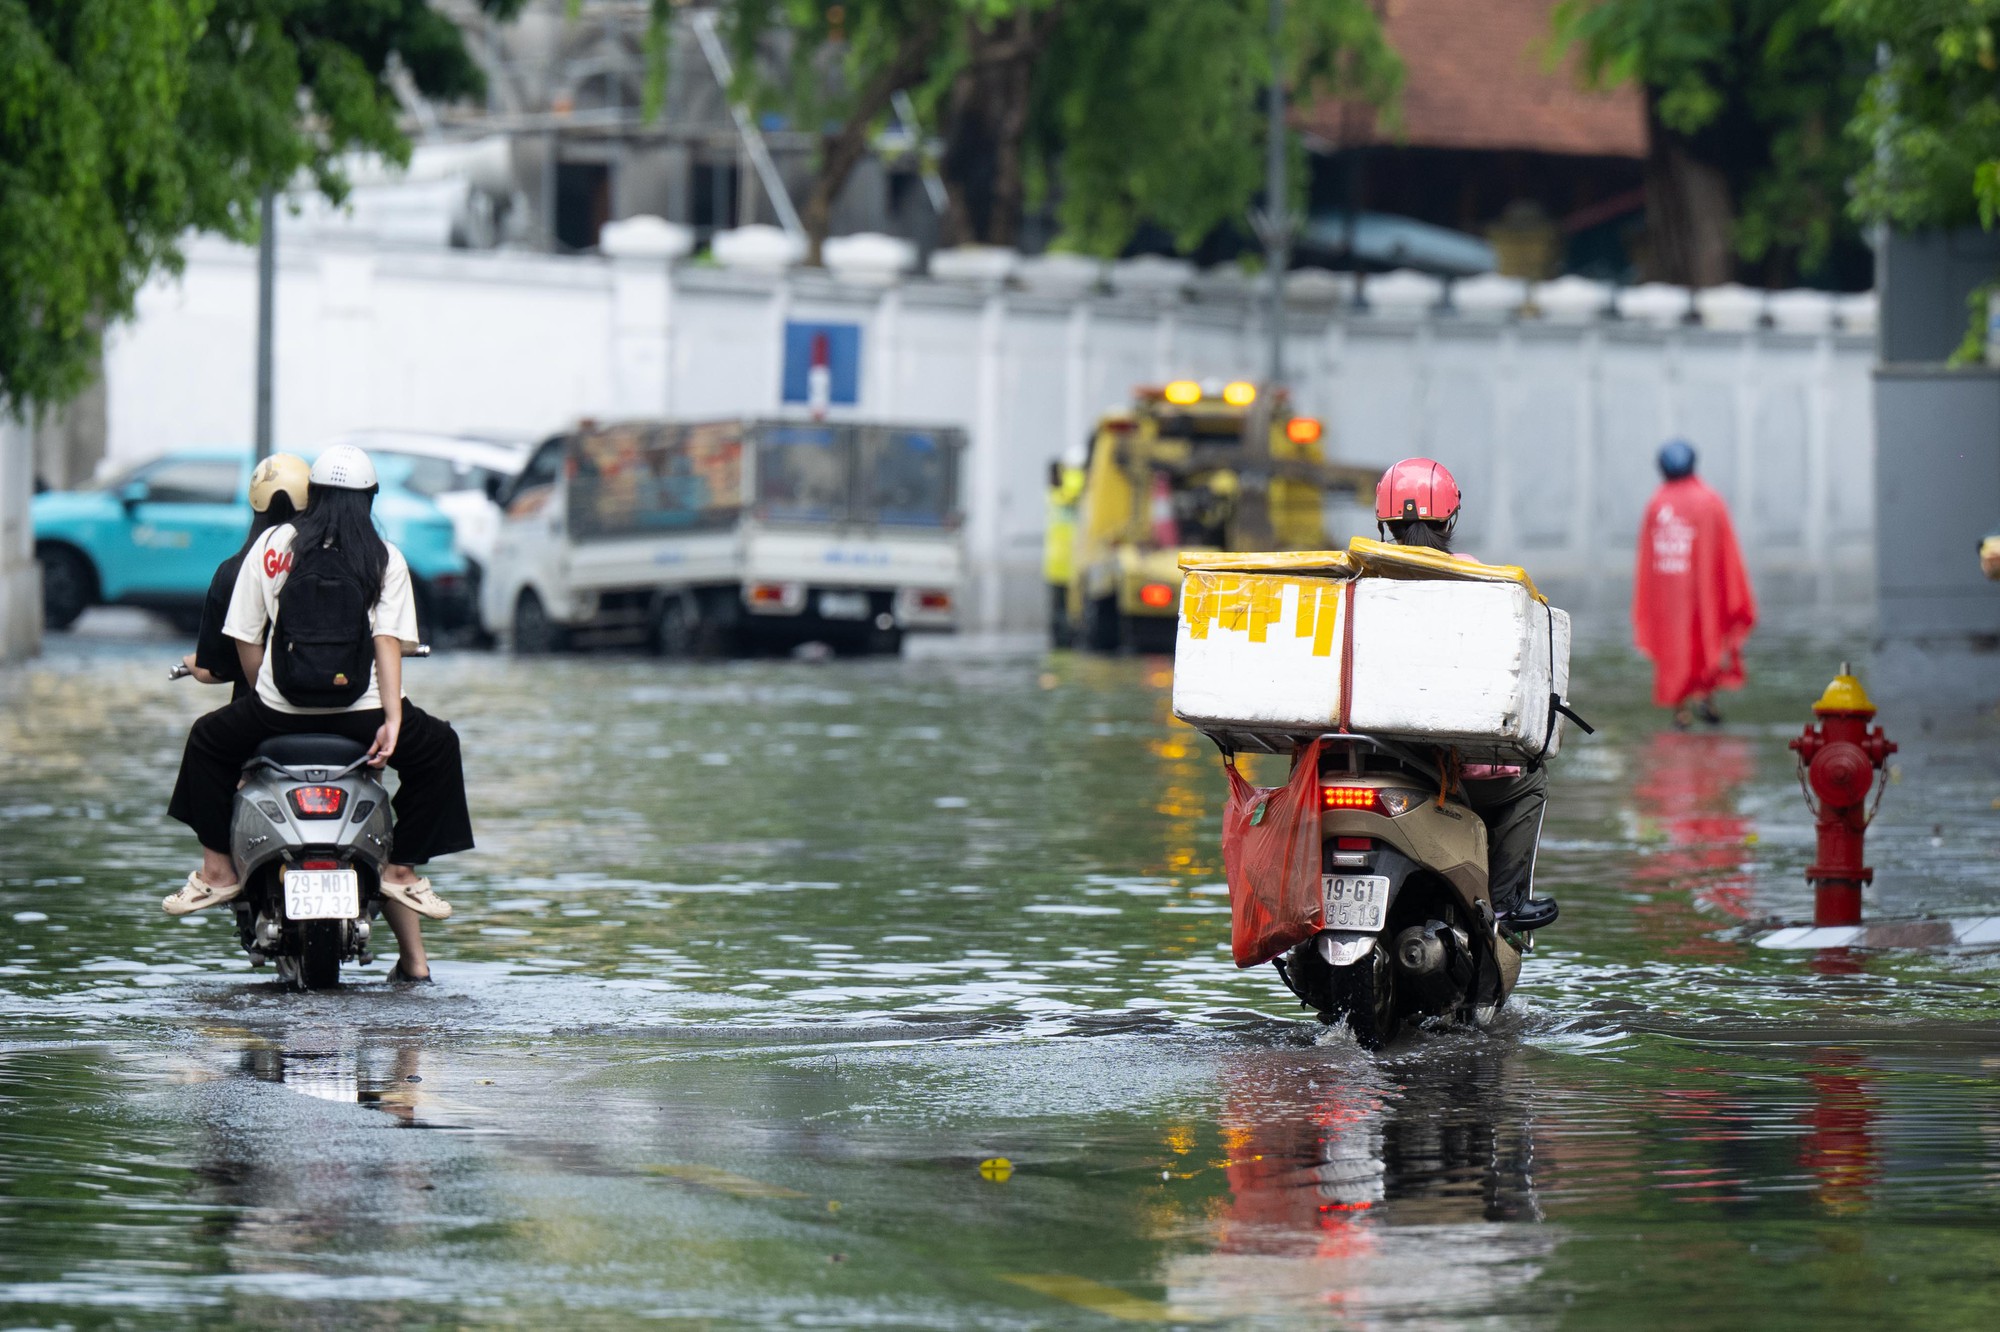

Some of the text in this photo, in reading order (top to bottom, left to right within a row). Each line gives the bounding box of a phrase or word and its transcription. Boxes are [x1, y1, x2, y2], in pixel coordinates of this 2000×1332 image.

[1325, 878, 1375, 902] 19-G1
[291, 895, 353, 915] 257.32
[1324, 903, 1380, 926] 85.19
